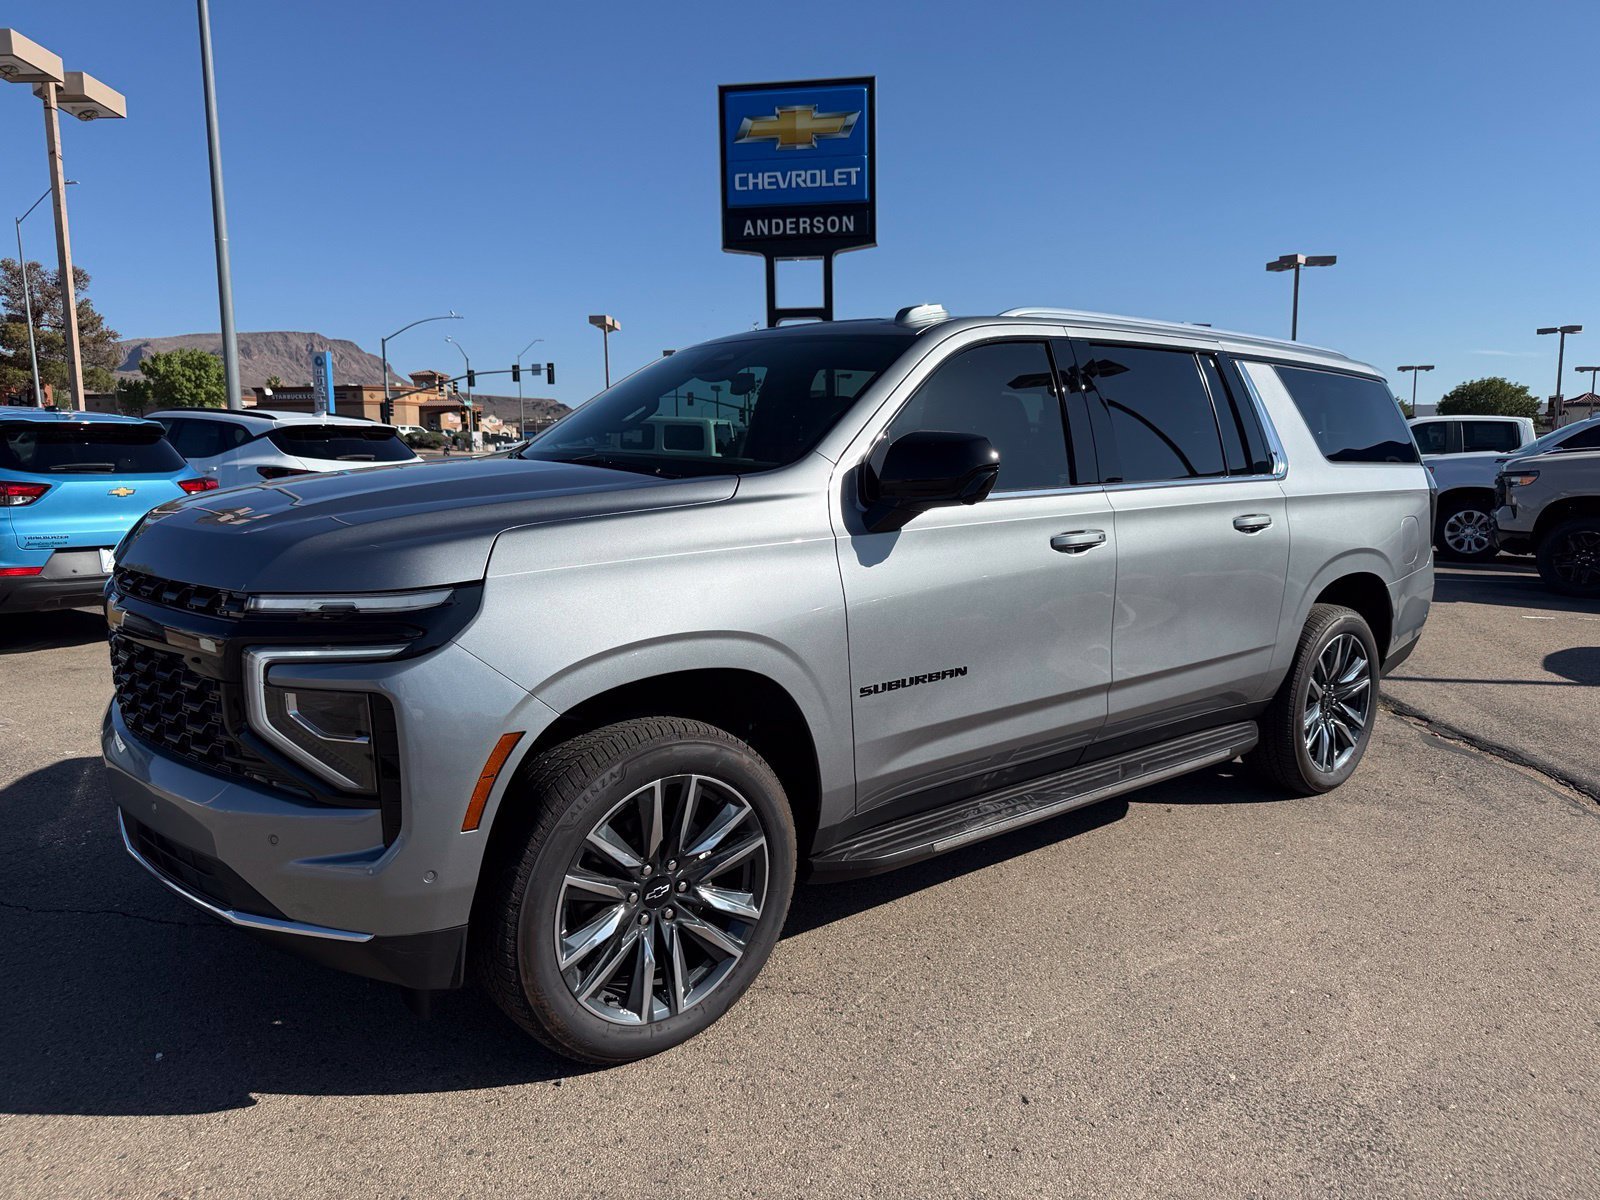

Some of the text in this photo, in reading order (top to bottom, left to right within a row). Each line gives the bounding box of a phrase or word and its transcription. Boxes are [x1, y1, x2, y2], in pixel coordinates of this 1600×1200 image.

[734, 167, 860, 191] CHEVROLET
[743, 215, 854, 236] ANDERSON
[859, 666, 968, 698] SUBURBAN
